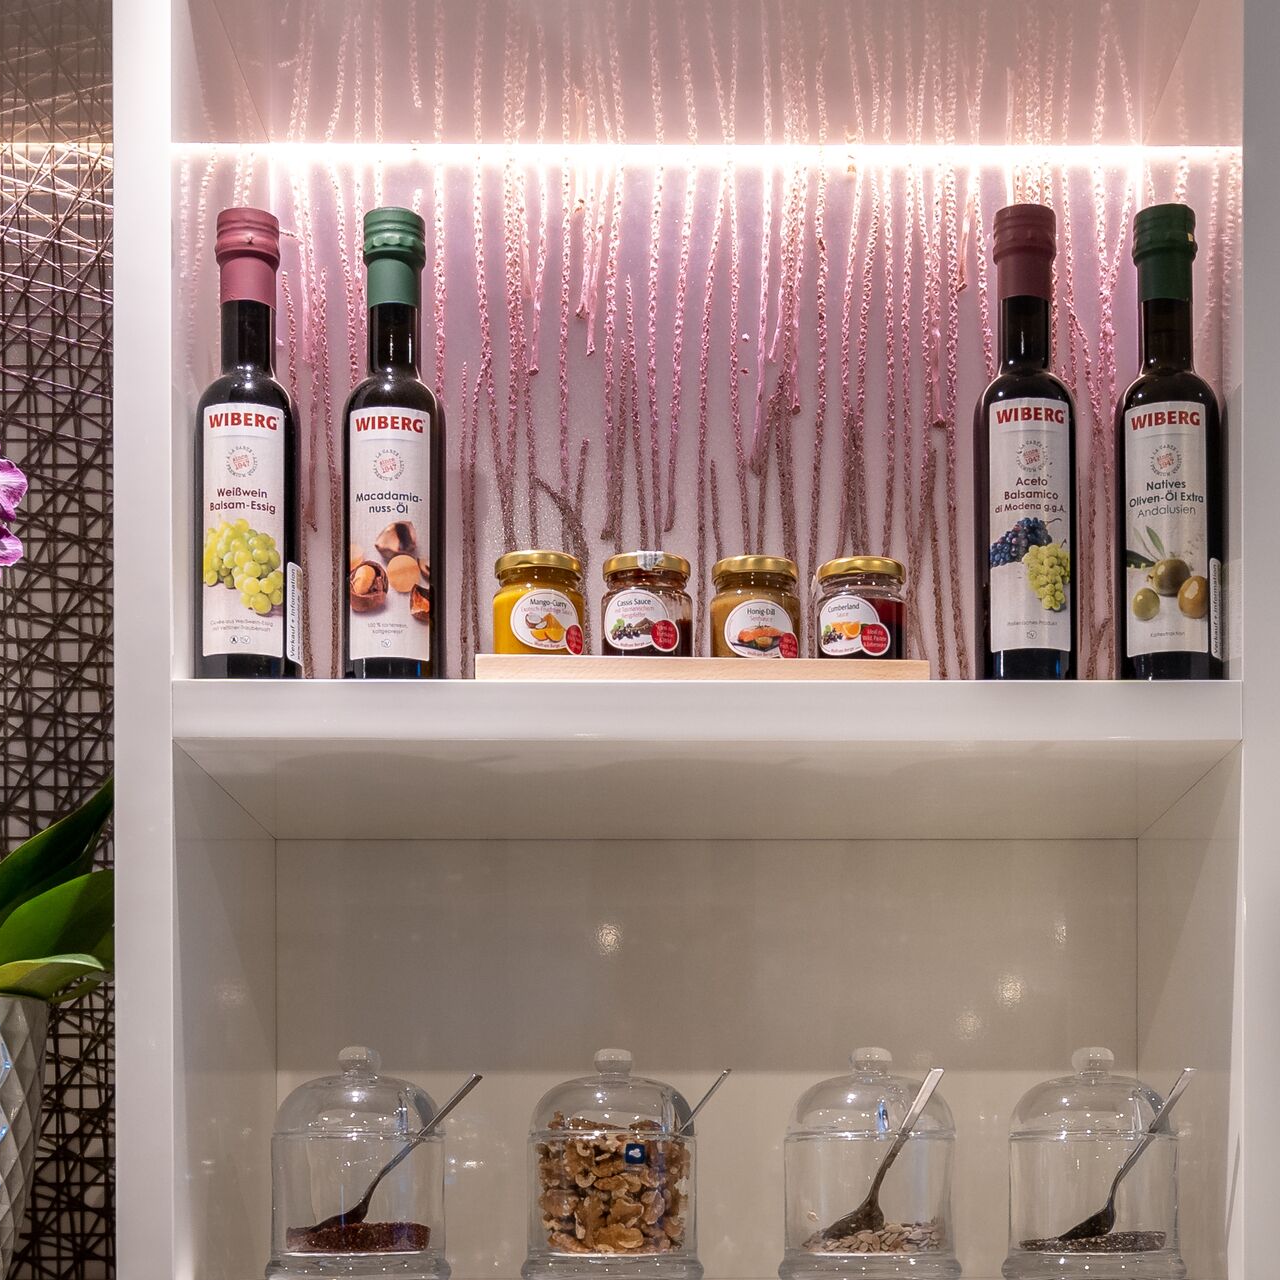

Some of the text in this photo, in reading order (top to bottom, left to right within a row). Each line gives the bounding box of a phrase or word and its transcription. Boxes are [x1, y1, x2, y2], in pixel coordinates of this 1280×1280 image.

[209, 412, 278, 431] WIBERG
[996, 407, 1065, 425] WIBERG
[1131, 410, 1201, 431] WIBERG
[355, 415, 424, 434] WIBERG
[1016, 477, 1048, 486] Aceto
[1146, 479, 1186, 491] Natives
[217, 487, 268, 499] Weißwein
[356, 491, 423, 503] Macadamia-
[1004, 489, 1059, 500] Balsamico
[1129, 490, 1204, 508] Oliven-Öl Extra
[209, 501, 276, 515] Balsam-Essig
[369, 502, 409, 514] nuss-Öl
[995, 506, 1003, 514] di
[1004, 501, 1041, 512] Modena
[1137, 504, 1196, 519] Andalusien
[530, 598, 567, 609] Mango-Curry
[827, 603, 860, 613] Cumberland
